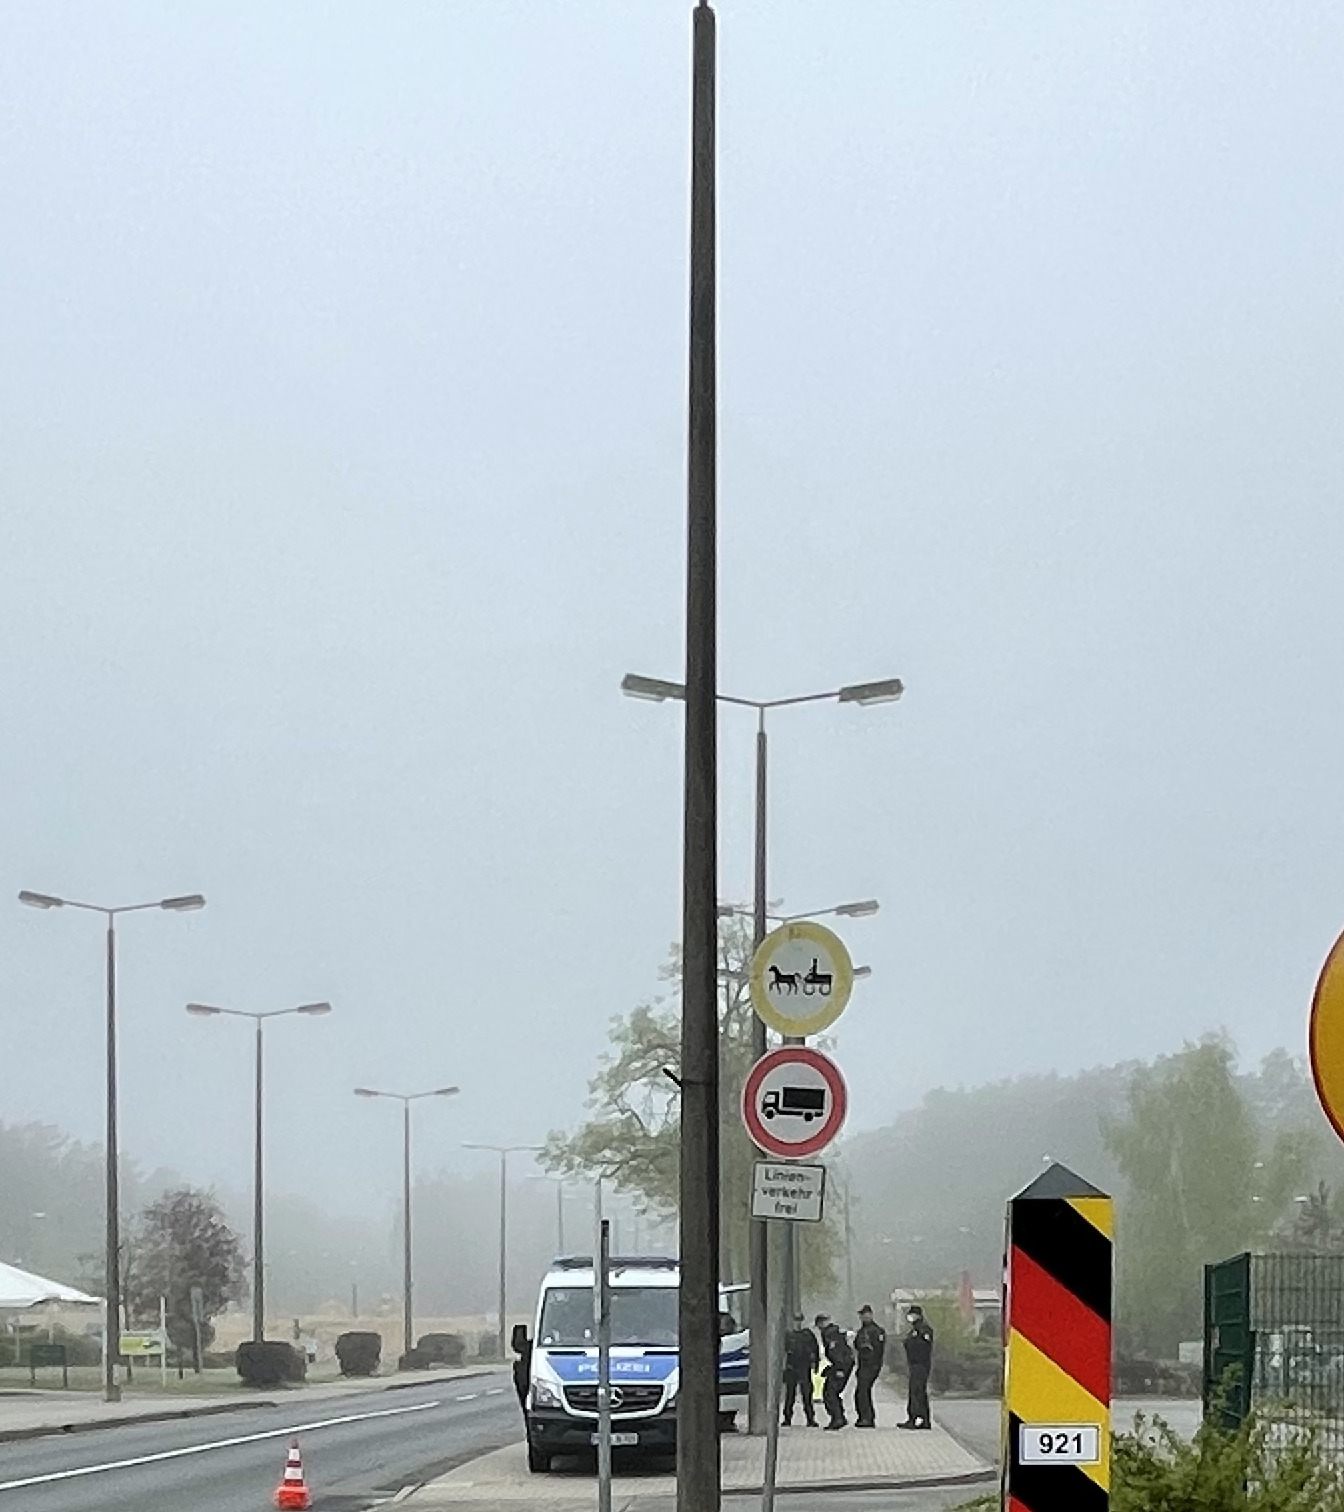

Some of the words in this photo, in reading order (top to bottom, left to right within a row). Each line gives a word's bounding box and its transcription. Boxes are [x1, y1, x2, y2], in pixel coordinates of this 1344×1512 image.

[764, 1167, 812, 1182] Linien-
[761, 1186, 813, 1200] verkehr
[774, 1201, 798, 1215] frei
[1039, 1432, 1083, 1454] 921
